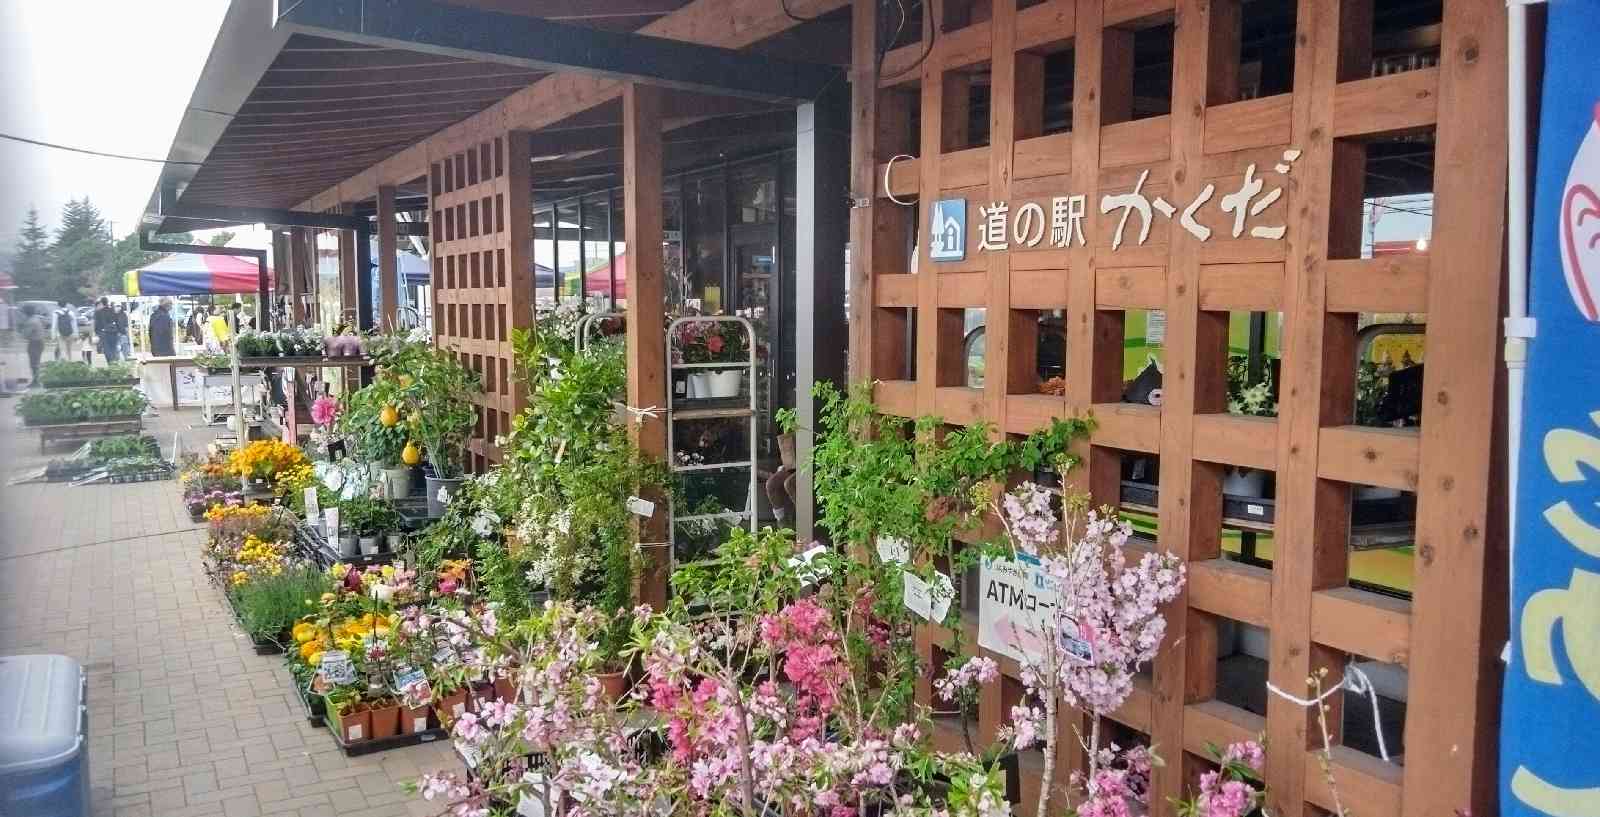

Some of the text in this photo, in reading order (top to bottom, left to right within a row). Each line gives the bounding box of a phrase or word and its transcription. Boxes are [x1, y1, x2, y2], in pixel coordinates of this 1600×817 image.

[978, 148, 1302, 253] 道の駅 かくだ
